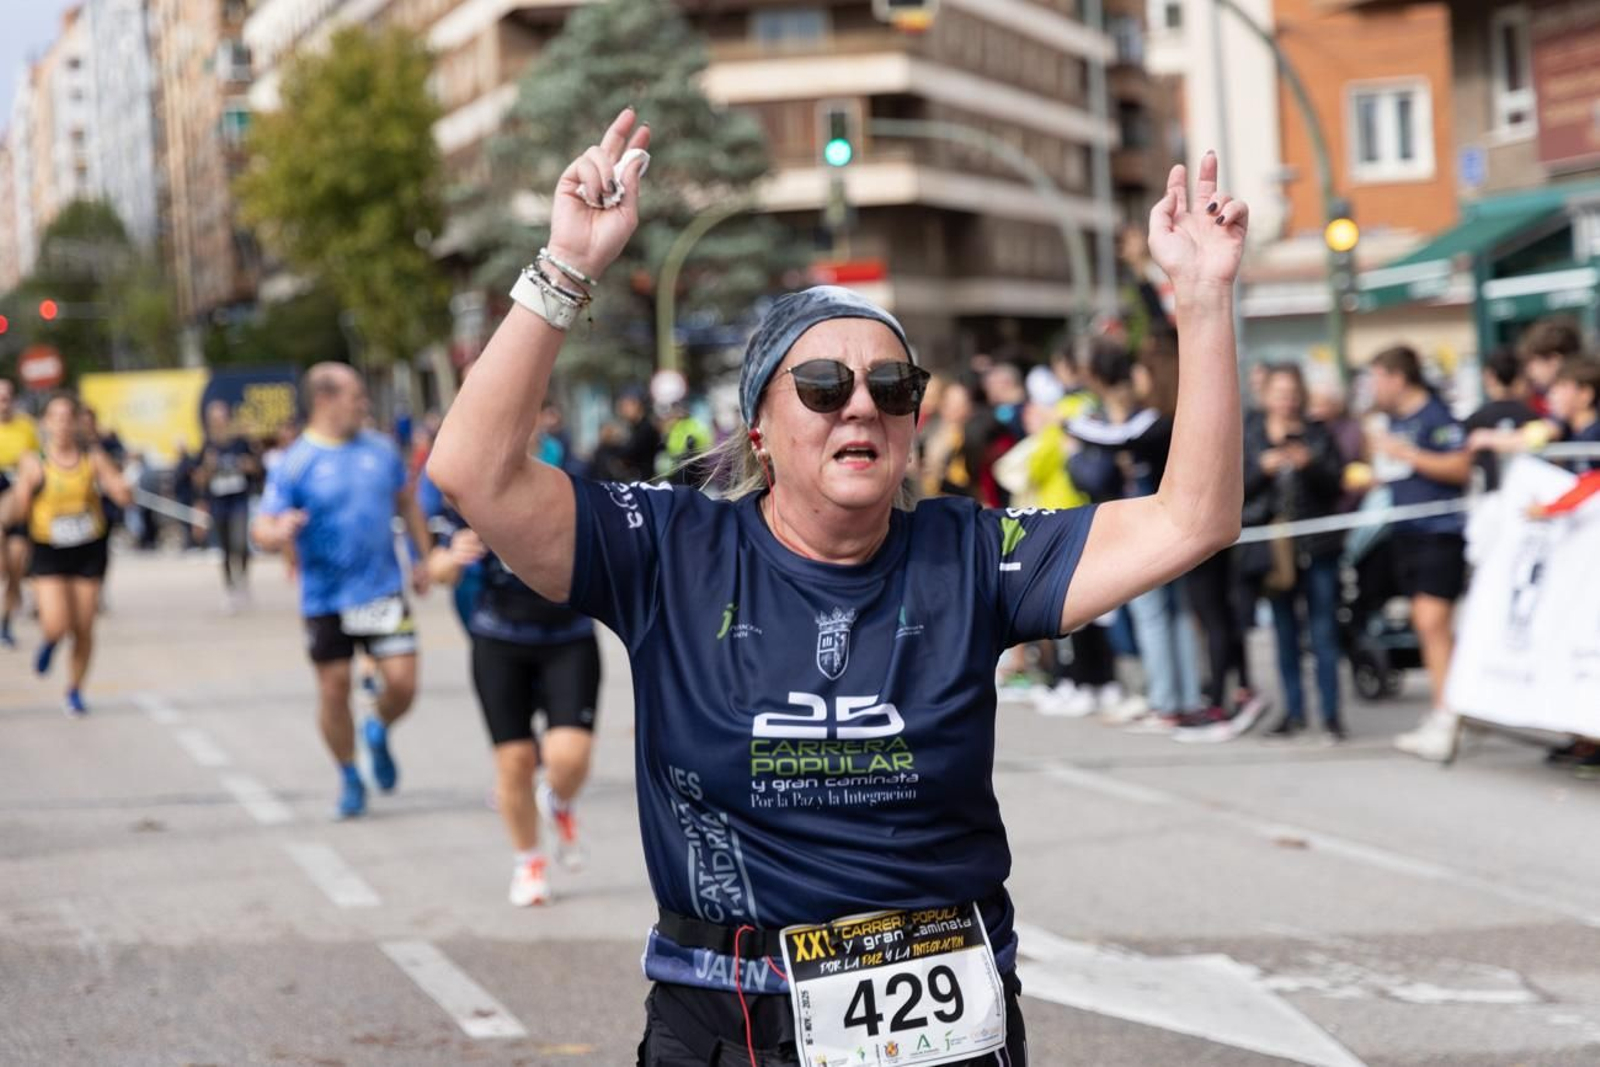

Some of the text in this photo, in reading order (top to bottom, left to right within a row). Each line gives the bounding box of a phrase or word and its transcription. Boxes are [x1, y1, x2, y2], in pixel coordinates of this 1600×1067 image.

[752, 691, 905, 739] 25
[751, 736, 908, 757] CARRERA
[750, 752, 915, 777] POPULAR
[751, 772, 919, 793] y gran caminata
[751, 793, 774, 809] Por
[777, 792, 789, 808] la
[793, 792, 813, 808] Paz
[828, 789, 840, 806] la
[844, 785, 917, 807] Integración
[911, 905, 959, 927] POPULA
[842, 917, 972, 955] y gran aminata
[819, 958, 842, 975] POR
[844, 955, 860, 970] LA
[861, 951, 885, 966] PAZ
[894, 945, 911, 960] LA
[843, 964, 965, 1037] 429
